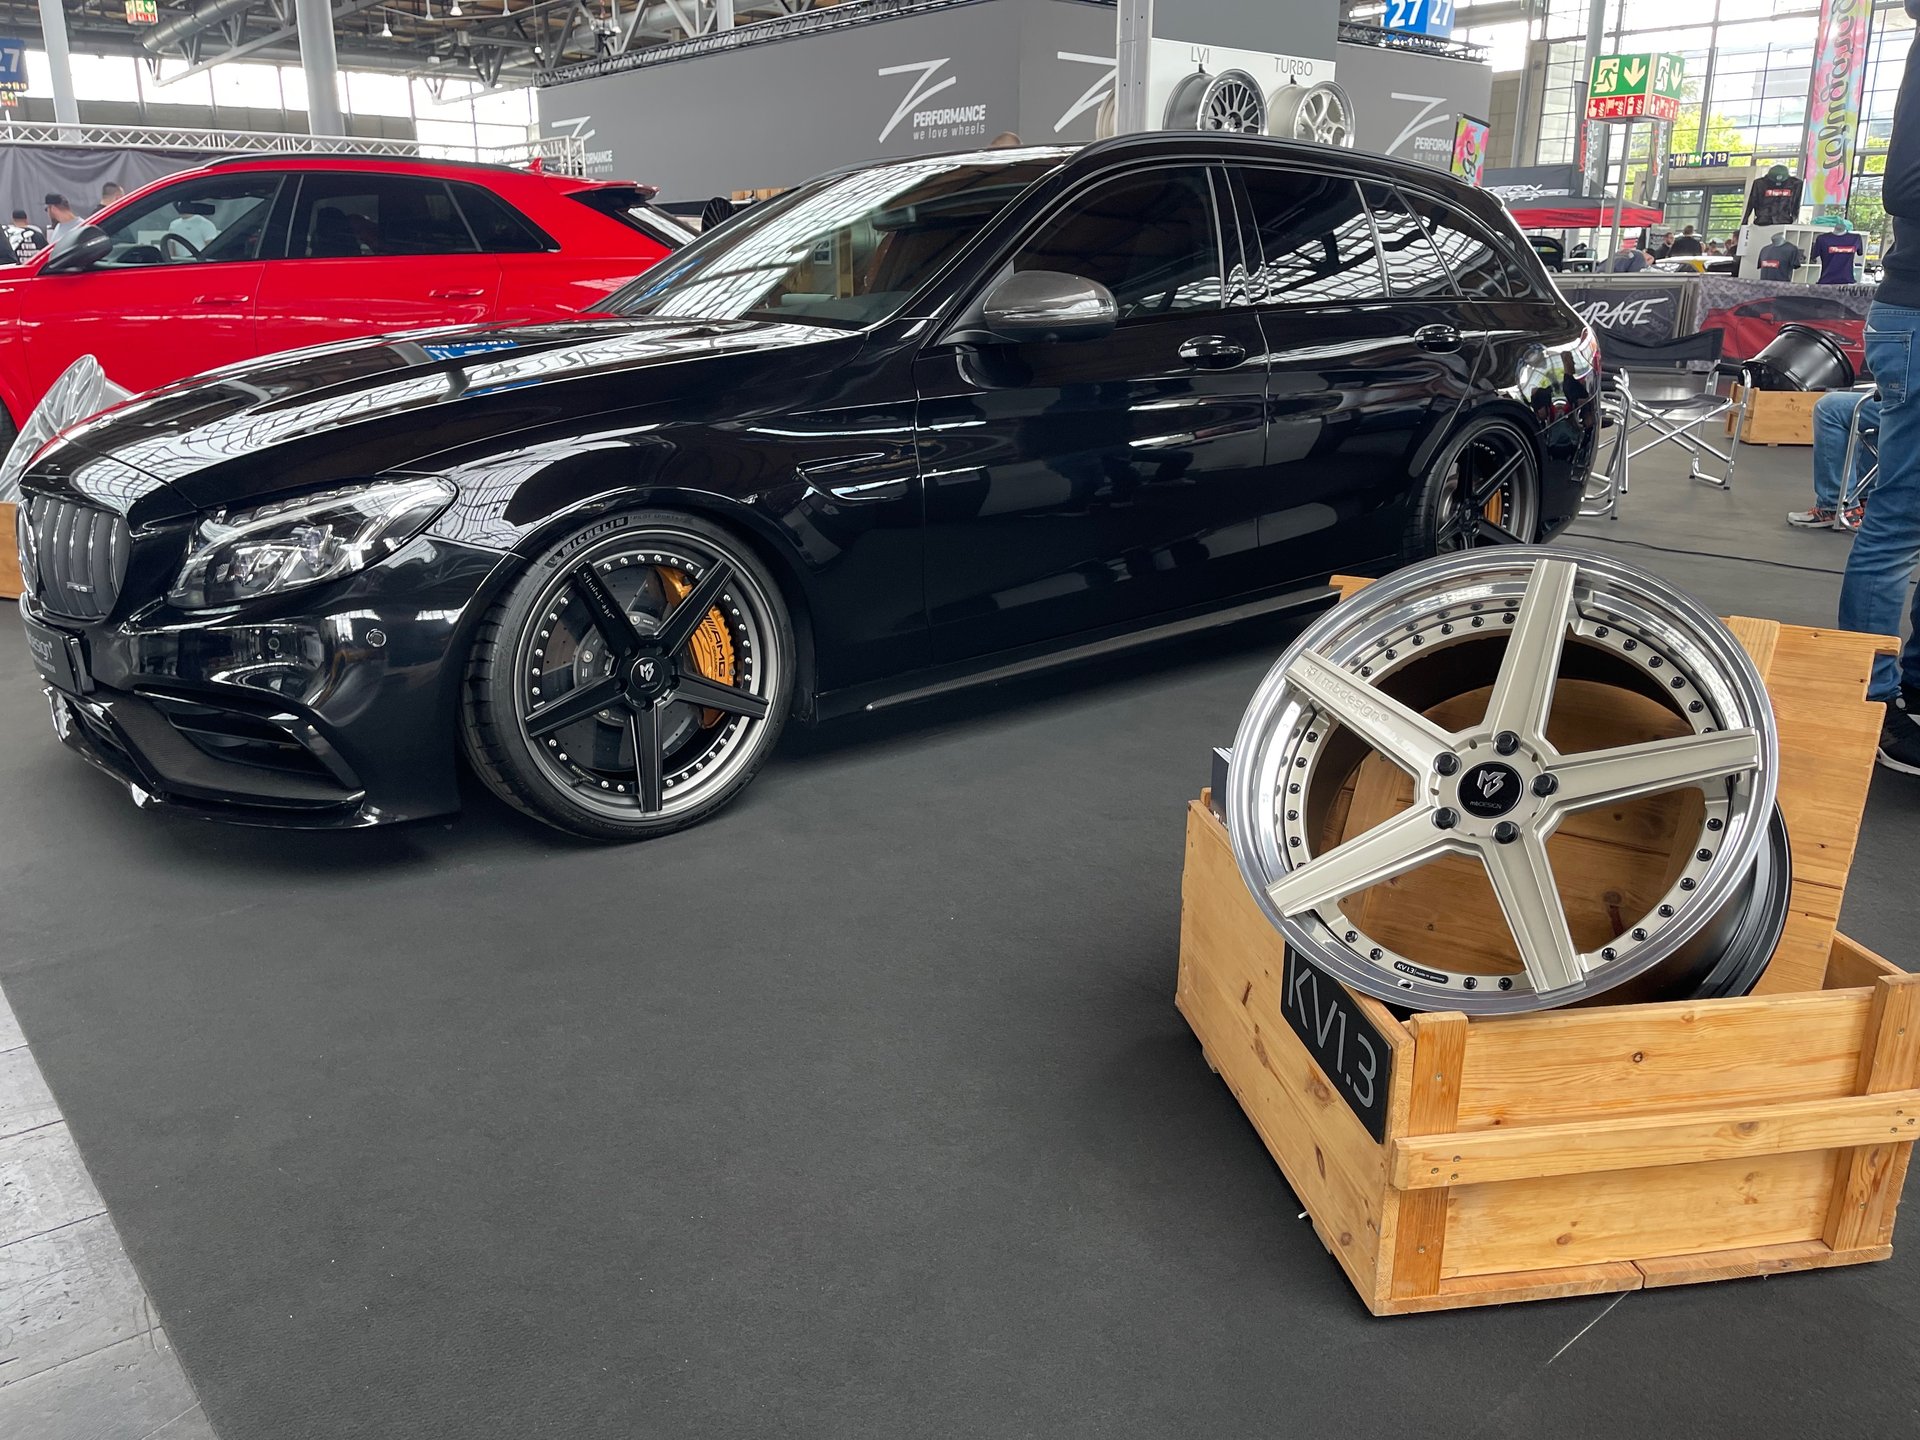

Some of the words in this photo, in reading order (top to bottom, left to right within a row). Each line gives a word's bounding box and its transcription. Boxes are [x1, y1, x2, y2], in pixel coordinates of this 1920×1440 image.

[1389, 0, 1421, 28] 27
[1430, 0, 1452, 26] 27
[1274, 57, 1313, 76] TURBO
[913, 104, 986, 128] PERFORMANCE
[913, 130, 925, 140] we
[928, 127, 948, 139] love
[951, 122, 986, 137] wheels
[1717, 152, 1728, 163] 13
[561, 516, 626, 557] MICHELIN
[711, 629, 726, 678] AMG
[1287, 948, 1377, 1108] KV1.3
